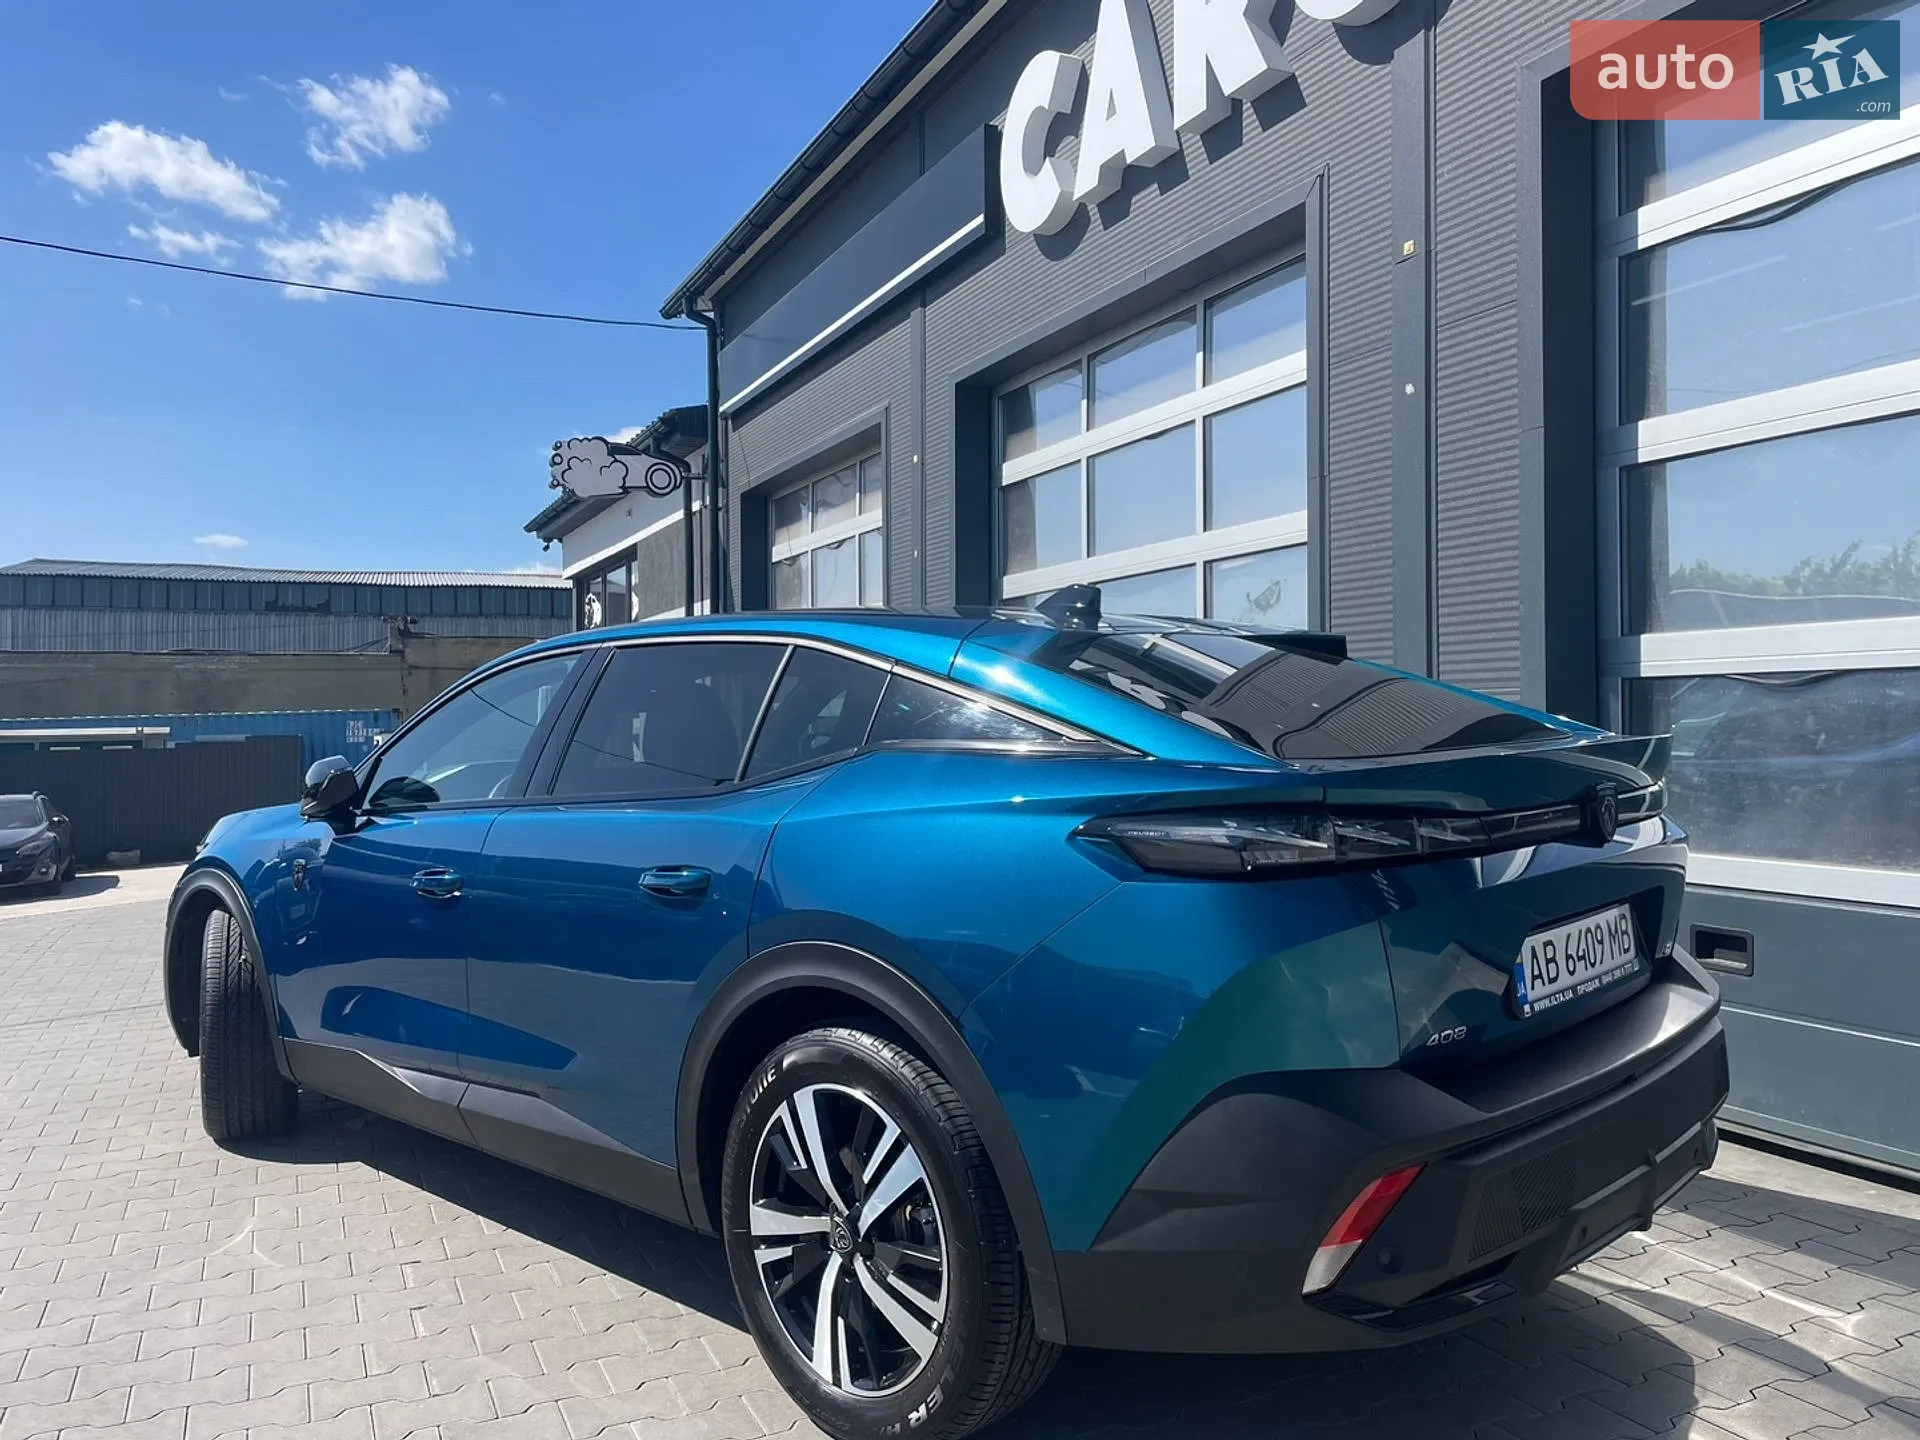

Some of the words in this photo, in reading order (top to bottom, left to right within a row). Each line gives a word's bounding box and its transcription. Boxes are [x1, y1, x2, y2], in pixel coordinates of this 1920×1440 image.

[1530, 938, 1560, 992] AB
[1565, 924, 1605, 976] 6409
[1606, 913, 1631, 960] MB
[1426, 1026, 1467, 1046] 408
